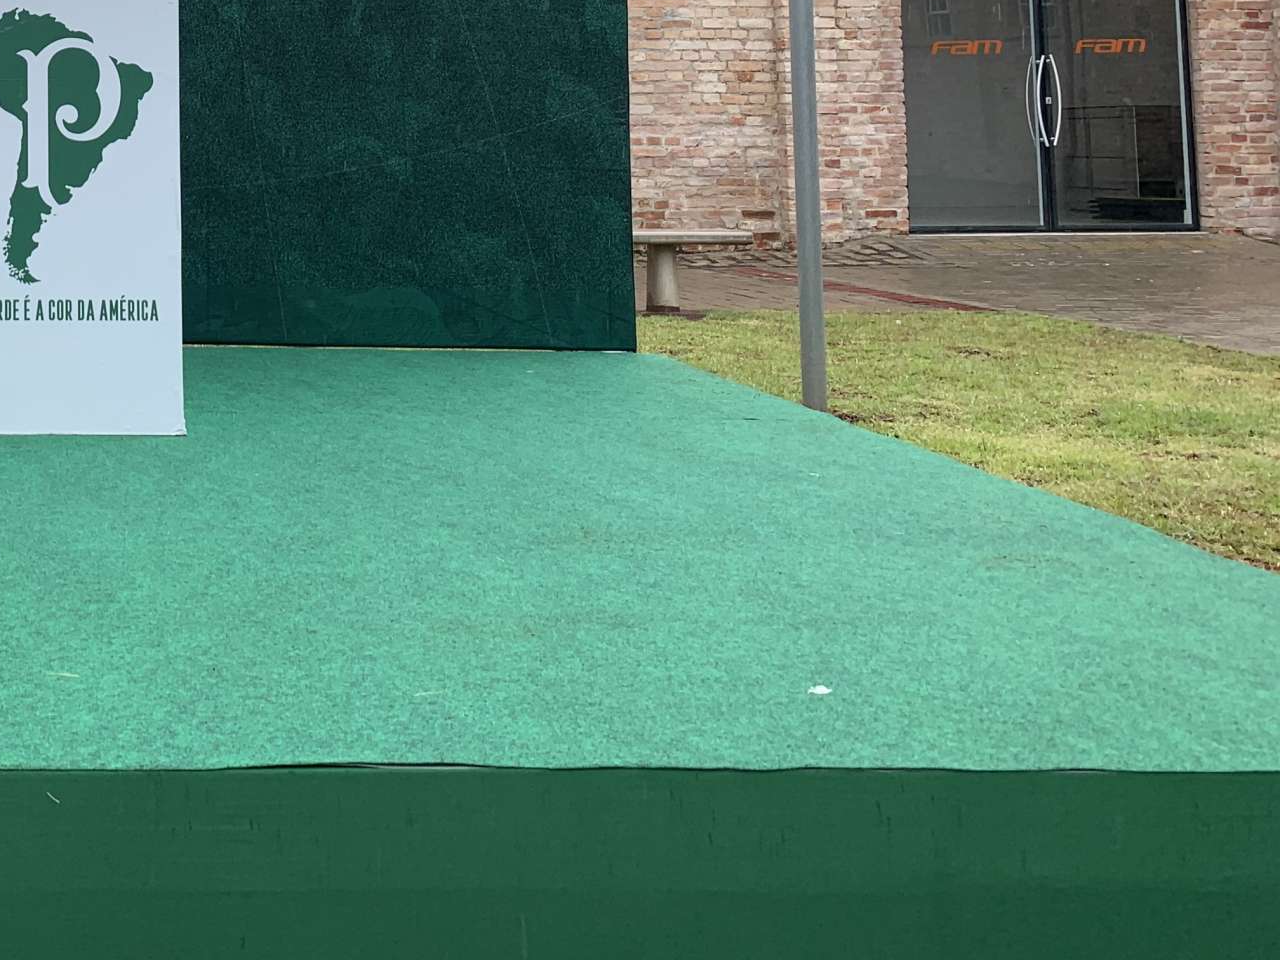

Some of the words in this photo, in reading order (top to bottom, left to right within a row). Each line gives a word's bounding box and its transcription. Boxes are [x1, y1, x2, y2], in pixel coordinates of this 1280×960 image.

[23, 294, 30, 321] É
[35, 299, 44, 321] A
[48, 299, 72, 321] COR
[78, 299, 95, 321] DA
[99, 294, 159, 321] AMÉRICA
